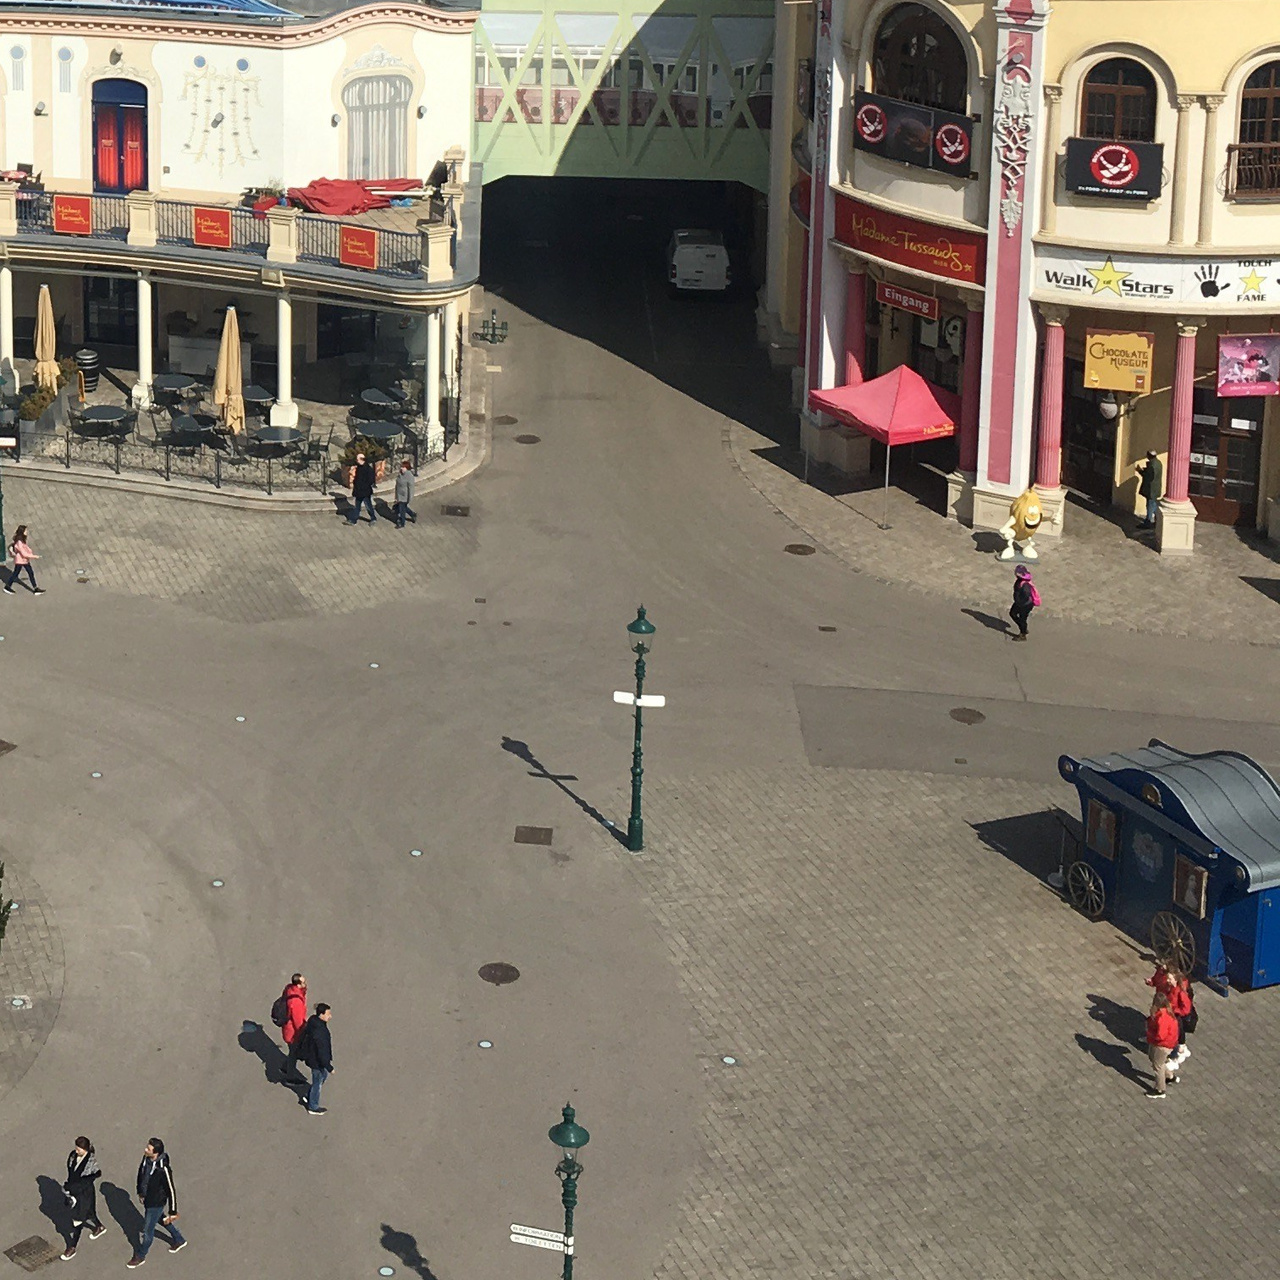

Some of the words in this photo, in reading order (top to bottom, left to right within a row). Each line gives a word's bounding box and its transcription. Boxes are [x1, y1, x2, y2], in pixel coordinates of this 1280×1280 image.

[852, 213, 899, 246] Madame
[897, 231, 963, 271] Tussauds
[1045, 270, 1094, 288] Walk
[1121, 279, 1174, 295] Stars
[884, 288, 929, 313] Eingang
[1237, 294, 1267, 302] FAME
[1089, 342, 1148, 359] CHOCOLATE
[1111, 357, 1148, 371] MUSEUM
